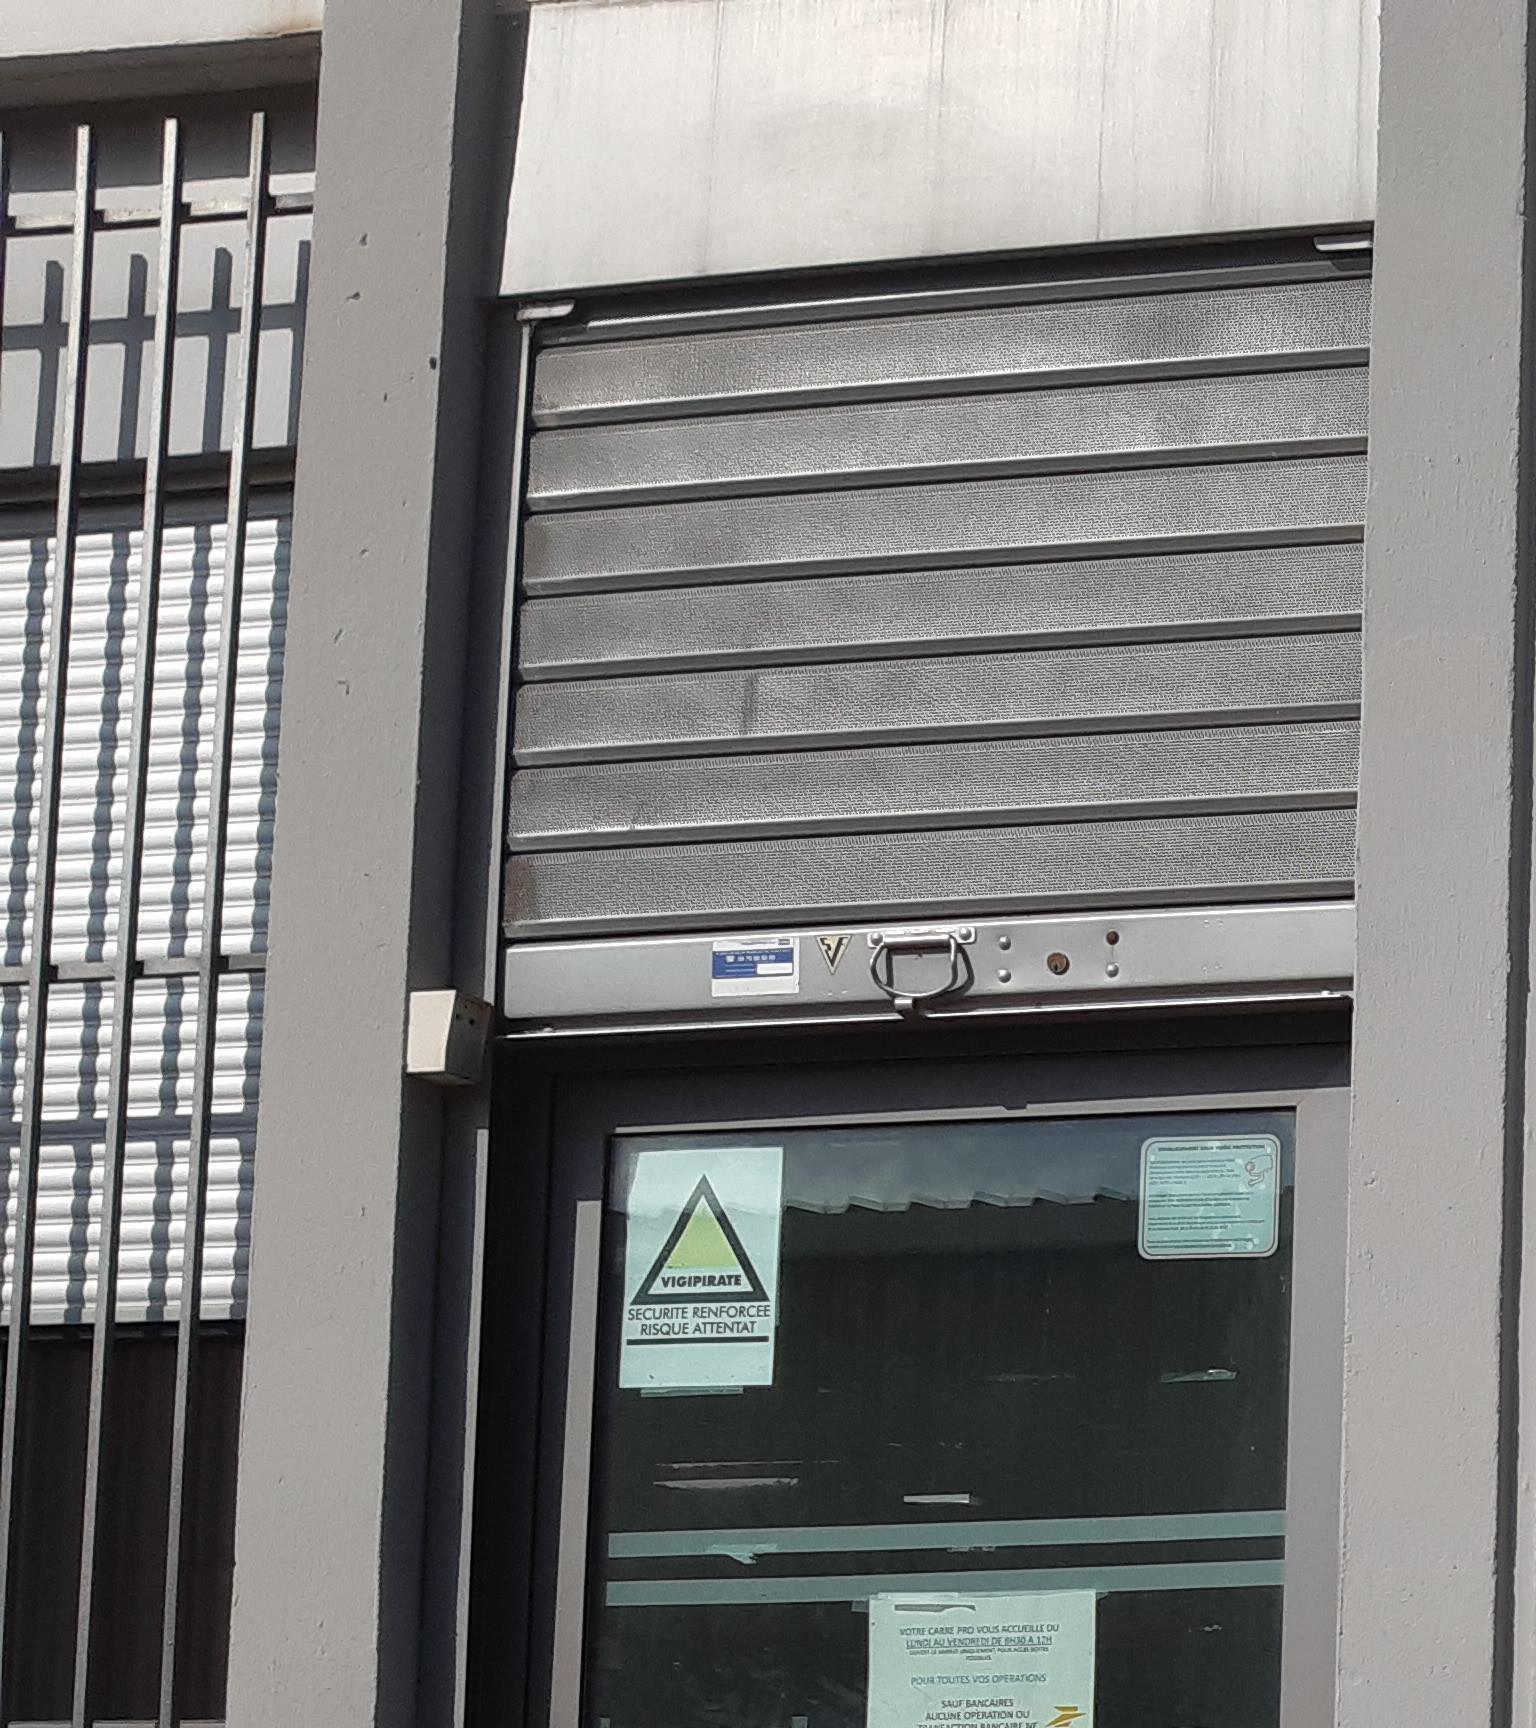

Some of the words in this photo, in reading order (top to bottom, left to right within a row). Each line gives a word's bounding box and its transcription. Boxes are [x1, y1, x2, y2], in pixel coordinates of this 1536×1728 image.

[661, 1275, 742, 1288] VIGIPIRATE
[628, 1307, 688, 1321] SECURITE
[692, 1305, 771, 1319] RENFORCEE
[640, 1323, 689, 1336] RISQUE
[693, 1321, 757, 1334] ATTENTAT
[957, 1625, 974, 1635] PRO
[977, 1625, 999, 1634] VOUS
[911, 1676, 934, 1686] POUR
[936, 1675, 970, 1684] TOUTES
[973, 1675, 990, 1684] VOS
[942, 1700, 964, 1709] SAUF
[966, 1698, 1014, 1708] BANCAIRES
[925, 1711, 961, 1721] AUCUNE
[1016, 1710, 1030, 1719] OU
